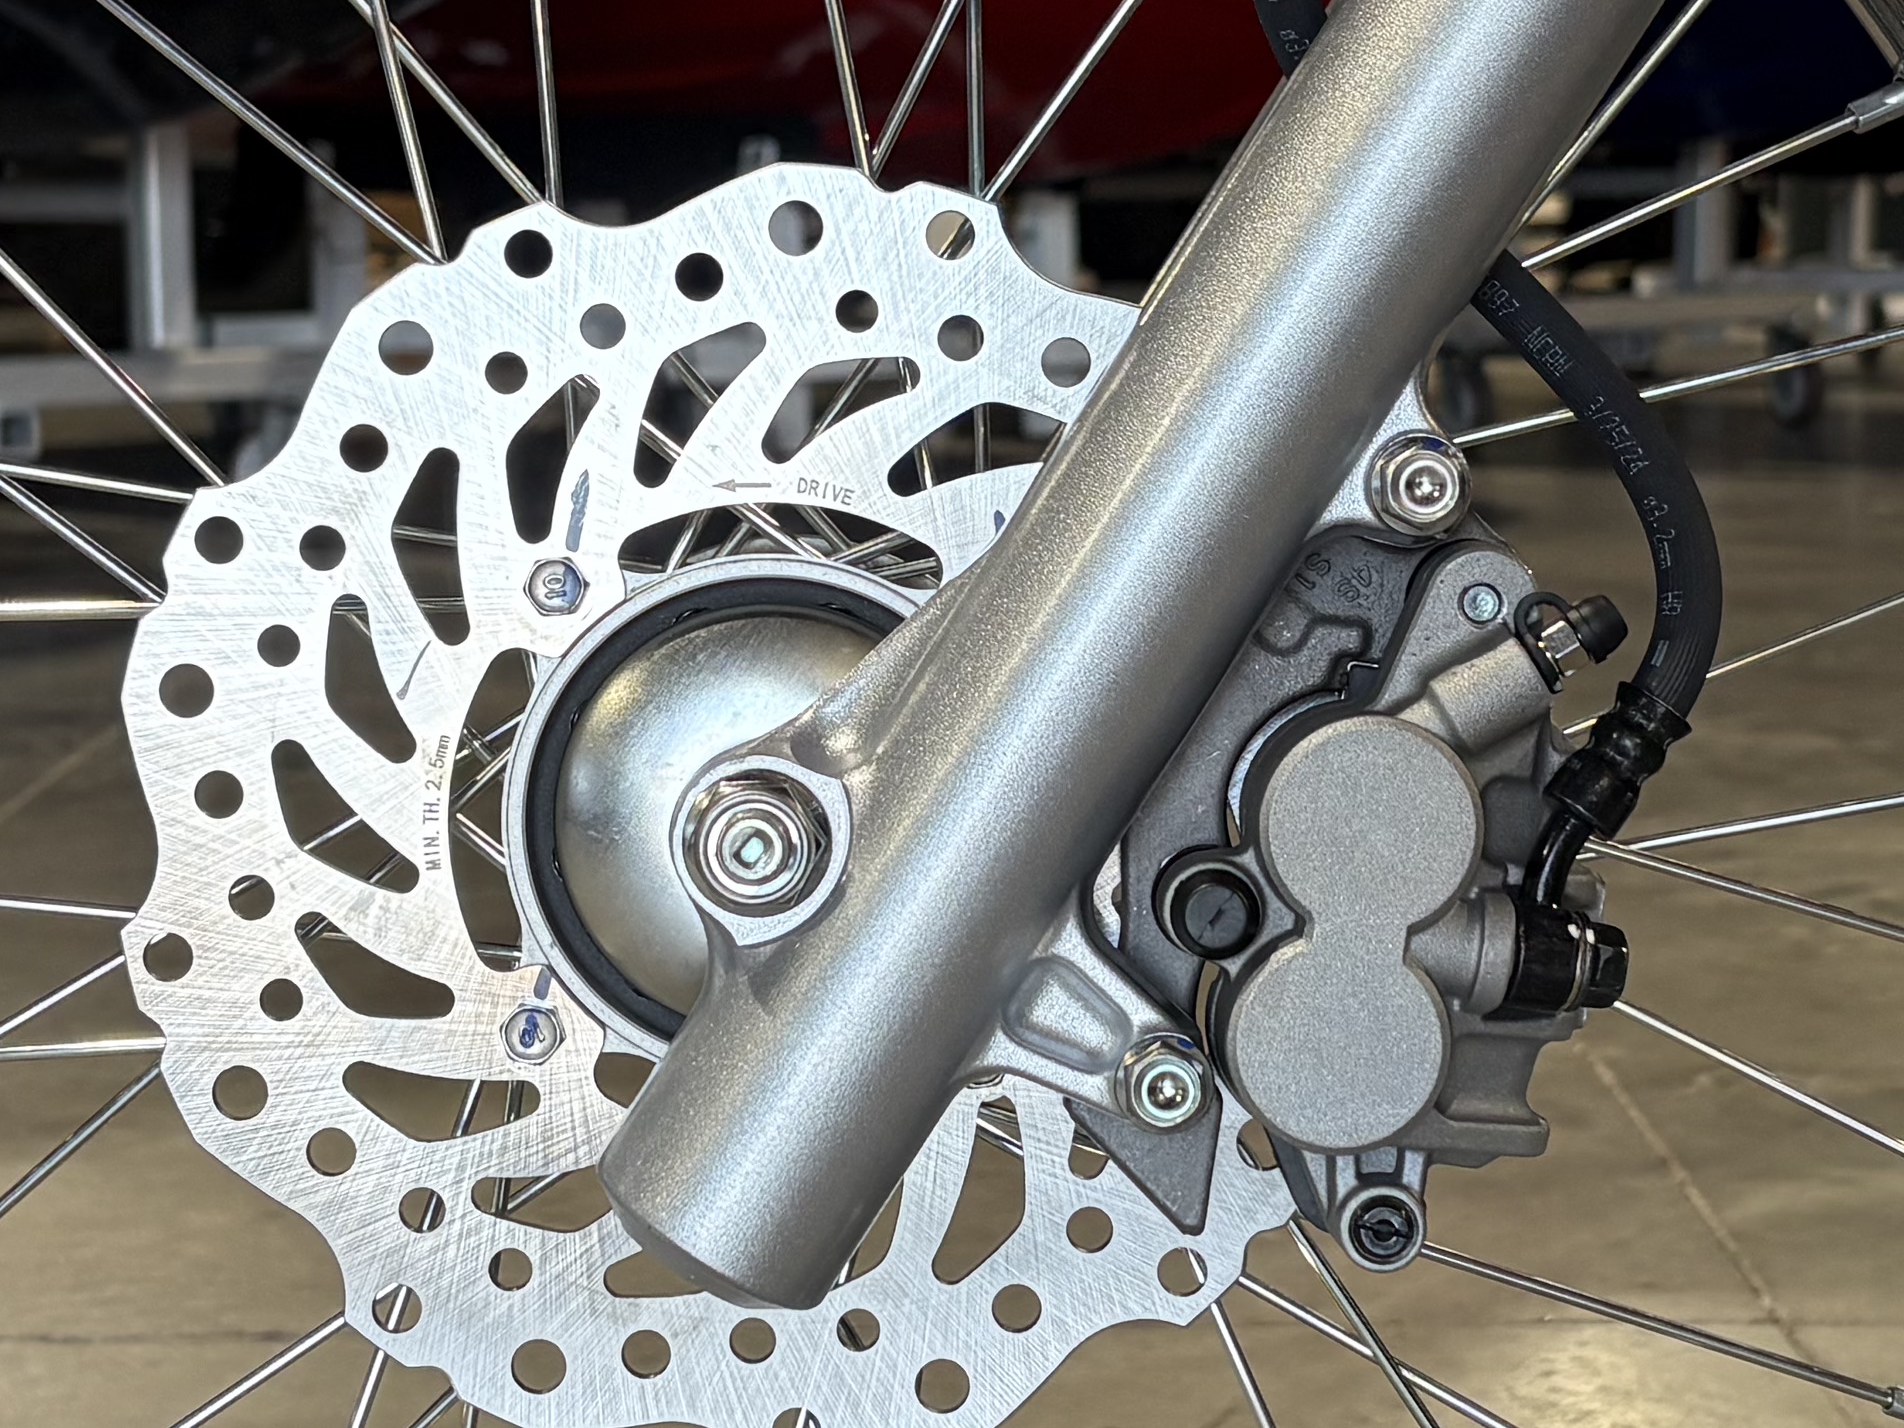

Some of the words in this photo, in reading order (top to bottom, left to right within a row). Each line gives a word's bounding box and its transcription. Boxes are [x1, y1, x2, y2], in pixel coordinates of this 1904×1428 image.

[796, 476, 856, 507] DRIVE
[424, 734, 452, 792] 2.5mm
[421, 797, 442, 825] TH.
[422, 830, 443, 872] MIN.
